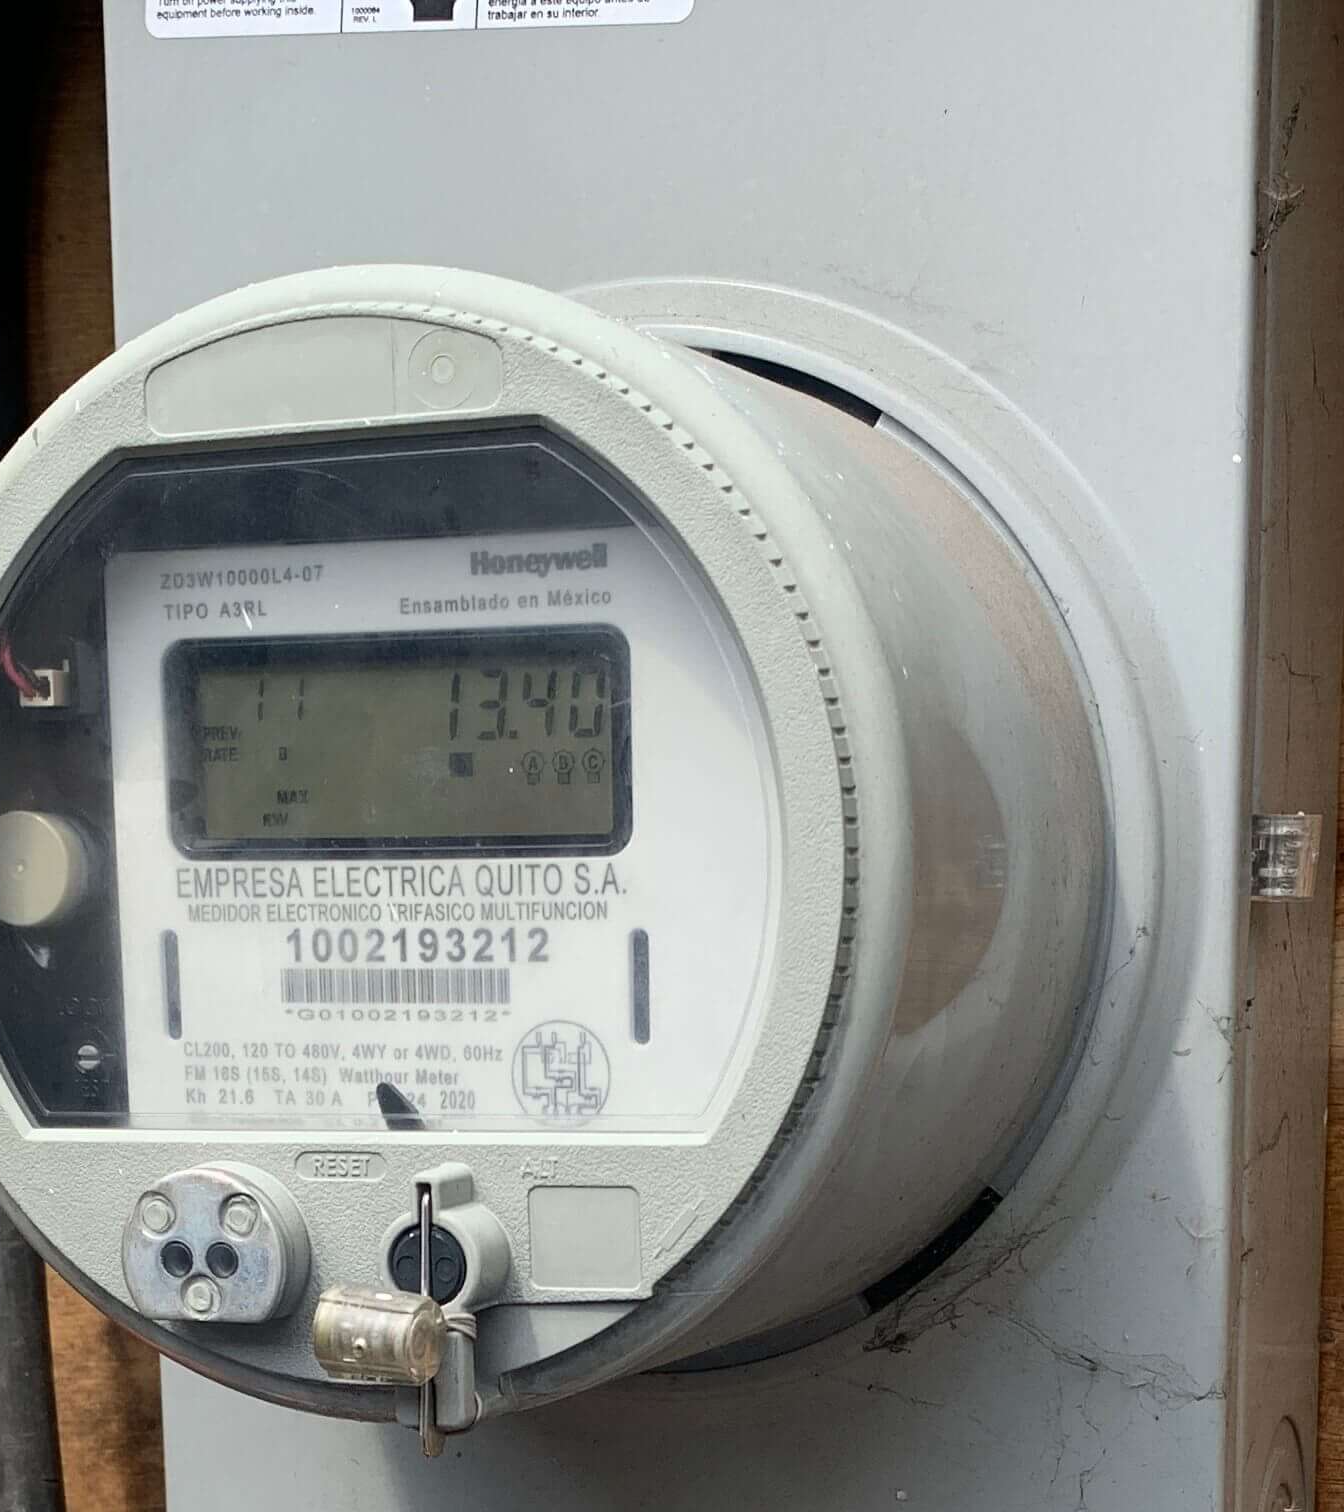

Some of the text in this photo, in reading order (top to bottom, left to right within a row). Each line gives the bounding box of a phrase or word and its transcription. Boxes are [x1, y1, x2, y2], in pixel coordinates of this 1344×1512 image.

[156, 9, 207, 21] equipment
[210, 8, 241, 18] before
[244, 7, 282, 19] working
[488, 9, 527, 21] trabajar
[531, 10, 543, 19] en
[547, 10, 559, 19] su
[470, 542, 608, 579] Honeywell
[164, 599, 268, 621] TIPO A3RL
[399, 587, 613, 616] Ensamblado en México
[449, 668, 607, 741] 13.40
[176, 862, 628, 899] EMPRESA ELECTRICA QUITO S.A.
[188, 900, 609, 923] MEDIDOR ELECTRONICO TRIFASICO MULTIFUNCION
[286, 926, 550, 964] 1002193212
[183, 1040, 236, 1060] CL200,
[242, 1042, 269, 1058] 120
[274, 1042, 296, 1059] TO
[351, 1043, 387, 1061] 4WY
[394, 1047, 409, 1061] or
[463, 1045, 504, 1062] 60Hz
[184, 1064, 207, 1081] FM
[294, 1066, 328, 1087] 14S)
[339, 1067, 409, 1084] Watthour
[415, 1068, 460, 1086] Meter
[185, 1088, 207, 1105] Kh
[218, 1088, 255, 1105] 21.6
[273, 1089, 297, 1106] TA
[306, 1090, 326, 1106] 30
[330, 1089, 344, 1106] A
[440, 1090, 477, 1110] 2020
[313, 1157, 371, 1178] RESET
